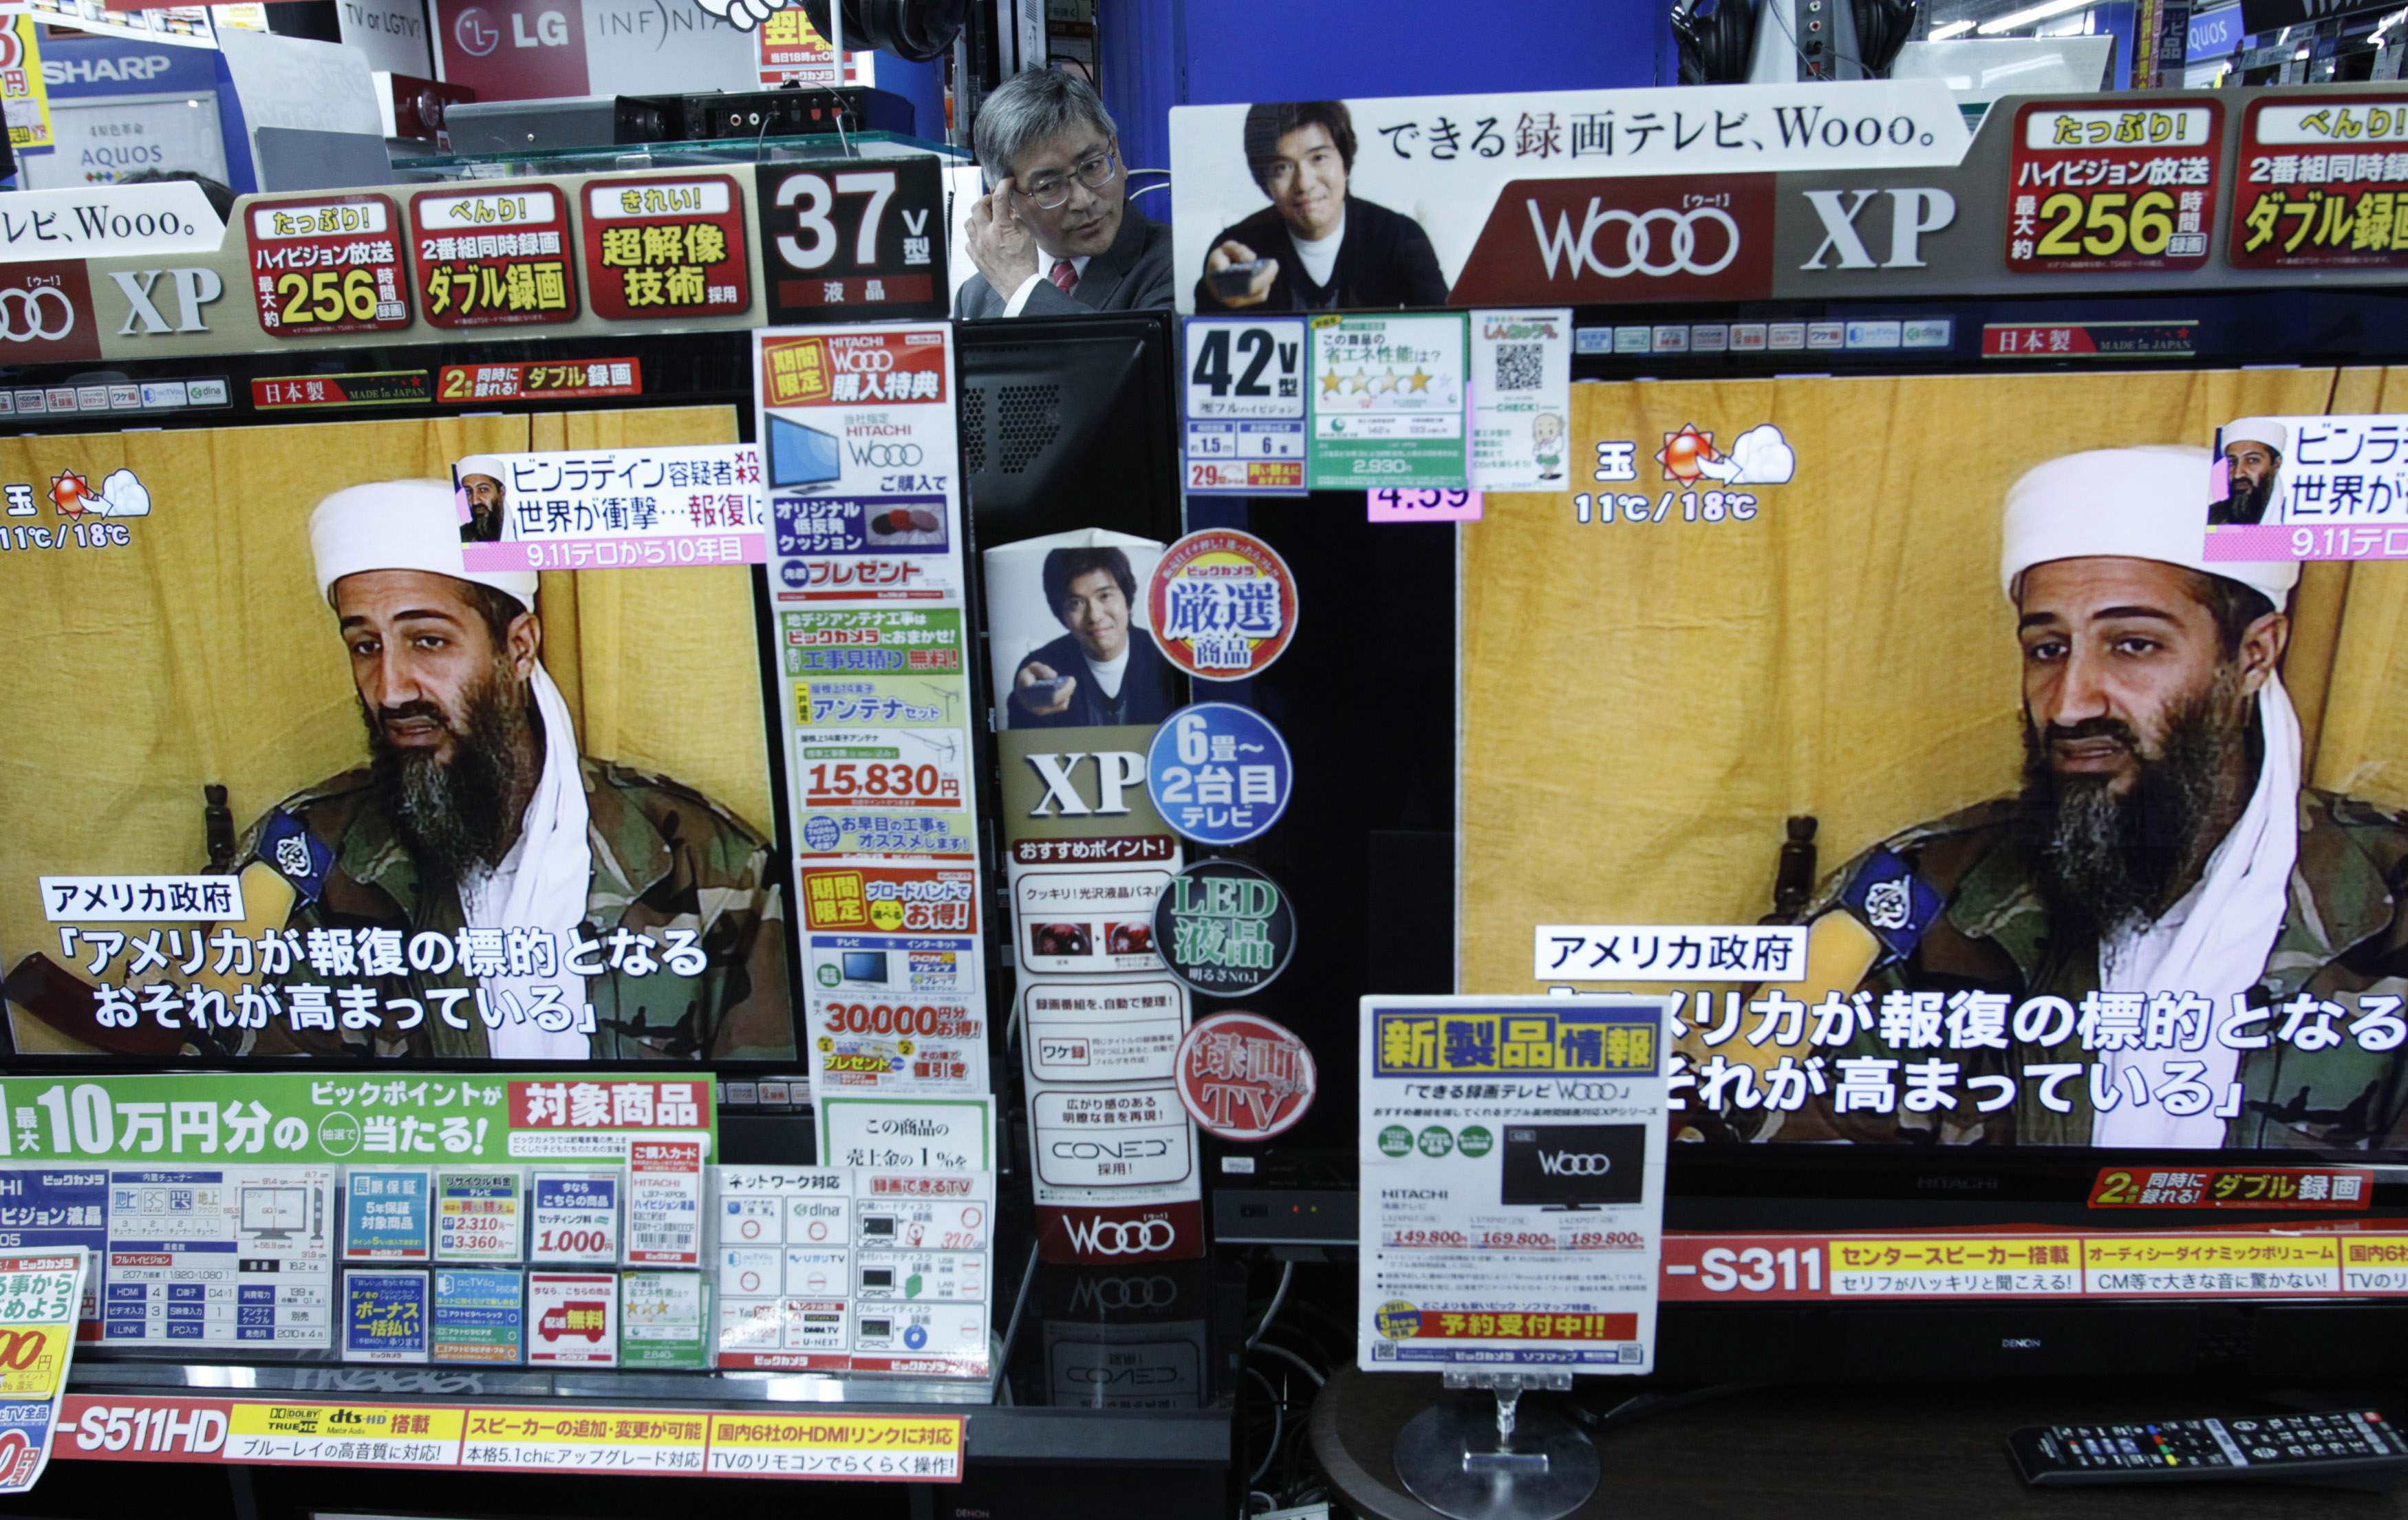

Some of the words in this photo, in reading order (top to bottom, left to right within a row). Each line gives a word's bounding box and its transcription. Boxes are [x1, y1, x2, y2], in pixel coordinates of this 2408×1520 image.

[346, 3, 362, 25] TV
[367, 14, 379, 30] or
[383, 12, 420, 39] LGTV?
[512, 10, 568, 48] LG
[42, 55, 171, 85] SHARP
[1378, 105, 1934, 160] できる録画テレビ、Wooo。
[2054, 113, 2186, 144] たっぷり!
[2299, 108, 2407, 138] べんり!
[81, 145, 162, 167] AQUOS
[2018, 158, 2210, 187] ハイビジョン放送
[450, 199, 526, 223] べんり!
[621, 189, 701, 214] きれい!
[2178, 192, 2205, 233] 時間
[2, 205, 195, 242] レビ、Wooo。
[273, 208, 370, 235] たっぷり!
[773, 171, 899, 271] 37
[902, 209, 932, 265] V型
[1800, 185, 1955, 270] XP
[2012, 195, 2036, 260] 最大約
[2034, 191, 2175, 257] 256
[422, 231, 561, 260] 2番組同時録画
[601, 224, 726, 266] 超解像
[1527, 196, 1740, 281] Wooo
[256, 241, 395, 270] ハイビジョン放送
[277, 269, 378, 324] 256
[377, 268, 397, 302] 時間
[427, 262, 566, 316] ダブル録画
[623, 267, 706, 306] 技術
[823, 281, 886, 302] 液晶
[108, 267, 222, 336] XP
[258, 276, 279, 328] 最大約
[1323, 334, 1385, 344] この商品の
[1999, 329, 2072, 353] 日本製
[2100, 340, 2135, 351] MADE
[2138, 337, 2150, 350] in
[2153, 339, 2192, 351] JAPAN
[477, 367, 519, 383] 同時に
[1192, 328, 1275, 397] 42
[1278, 341, 1299, 398] V型
[528, 363, 632, 388] ダブル録画
[831, 372, 939, 403] 購入特典
[203, 386, 221, 396] dlna
[264, 376, 325, 403] 日本製
[349, 389, 378, 400] MADE
[380, 386, 391, 398] in
[392, 385, 425, 399] JAPAN
[475, 381, 517, 397] 録れる!
[1262, 438, 1271, 453] 6
[513, 451, 760, 493] ビンラディン容疑者殺
[1594, 441, 1636, 480] 玉
[6, 484, 37, 516] 玉
[776, 502, 861, 519] オリジナル
[528, 537, 743, 567] 9.11テロから10年目
[779, 535, 862, 552] クッション
[808, 560, 923, 586] プレゼント
[786, 611, 926, 627] 地デジアンテナ工事は
[1170, 582, 1273, 633] 厳選
[788, 629, 955, 645] ビックカメラにおまかせ!
[813, 698, 940, 720] アンテナセット
[808, 764, 938, 796] 15,830
[1026, 750, 1147, 816] XP
[1161, 764, 1276, 805] 2台目
[1181, 804, 1253, 828] テレビ
[1020, 838, 1165, 859] おすすめポイント!
[50, 881, 235, 914] アメリカ政府
[1170, 877, 1278, 919] LED
[873, 911, 902, 920] 選べる
[58, 925, 709, 978] 「アメリカが報復の標的となる
[1174, 918, 1274, 968] 液晶
[1549, 934, 1794, 972] アメリカ政府
[93, 983, 598, 1034] おそれが高まっている」
[825, 1003, 938, 1036] 30,000
[938, 1007, 966, 1019] 円分
[1382, 1017, 1651, 1068] 新製品情報
[921, 1051, 958, 1060] その場で
[1191, 1033, 1300, 1082] 録画
[311, 1080, 504, 1108] ビックポイントが
[525, 1081, 700, 1127] 対象商品
[36, 1083, 310, 1154] 10万円分の
[1202, 1084, 1287, 1132] TV
[362, 1115, 490, 1156] 当たる!
[866, 1119, 949, 1136] この商品の
[635, 1147, 697, 1159] ご購入カード
[43, 1175, 105, 1186] ビックカメラ
[142, 1173, 193, 1182] 内蔵チューナー
[447, 1177, 511, 1186] リサイクル料金
[562, 1183, 589, 1192] 今なら
[633, 1179, 680, 1187] HITACHI
[729, 1175, 840, 1190] ネットワーク対応
[2147, 1173, 2207, 1188] 同時に
[2215, 1175, 2363, 1201] ダブル録画
[543, 1195, 609, 1208] こちらの商品
[634, 1200, 695, 1211] ハイビジョン液晶
[1382, 1189, 1449, 1200] HITACHI
[2139, 1189, 2200, 1205] 録れる!
[361, 1217, 413, 1230] 対象商品
[539, 1215, 592, 1224] セッティング料
[538, 1230, 605, 1252] 1,000
[604, 1241, 613, 1252] 円
[1062, 1214, 1175, 1255] Wooo
[19, 1259, 74, 1270] ビックカメラ
[115, 1256, 170, 1265] フルハイビジョン
[250, 1262, 269, 1270] 重量
[938, 1256, 954, 1265] USB
[1842, 1244, 2070, 1266] センタースピーカー搭載
[2089, 1245, 2335, 1263] オーディシーダイナミックボリューム
[1666, 1247, 1823, 1292] -S311
[2098, 1271, 2328, 1291] CM等で大きな音に驚かない!
[2347, 1273, 2408, 1289] TVのリ
[152, 1288, 160, 1297] 4
[534, 1287, 612, 1296] 今なら、こちらの商品
[1842, 1273, 2072, 1292] セリフがハッキリと聞こえる!
[110, 1307, 143, 1316] ビデオ入力
[151, 1307, 160, 1316] 3
[242, 1308, 269, 1316] アンテナ
[292, 1312, 309, 1321] 別売
[355, 1303, 418, 1319] ボーナス
[859, 1305, 931, 1314] ブルーレイディスク
[246, 1330, 266, 1338] 発売月
[355, 1319, 419, 1337] 一括払い
[1440, 1313, 1606, 1338] 予約受付中!!
[389, 1338, 421, 1347] 承ります
[2001, 1338, 2041, 1348] DENON
[754, 1356, 808, 1366] ビックカメラ
[1455, 1350, 1515, 1361] ビックカメラ
[1523, 1352, 1578, 1362] ソフマップ
[54, 1405, 228, 1455] -S511HD
[470, 1417, 703, 1440] スピーカーの追加・変更が可能
[716, 1423, 954, 1446] 国内6社のHDMIリンクに対応
[242, 1439, 441, 1463] ブルーレイの高音質に対応!
[466, 1446, 702, 1470] 本格5.1chにアップグレード対応
[711, 1451, 955, 1475] TVのリモコンでらくらく操作!
